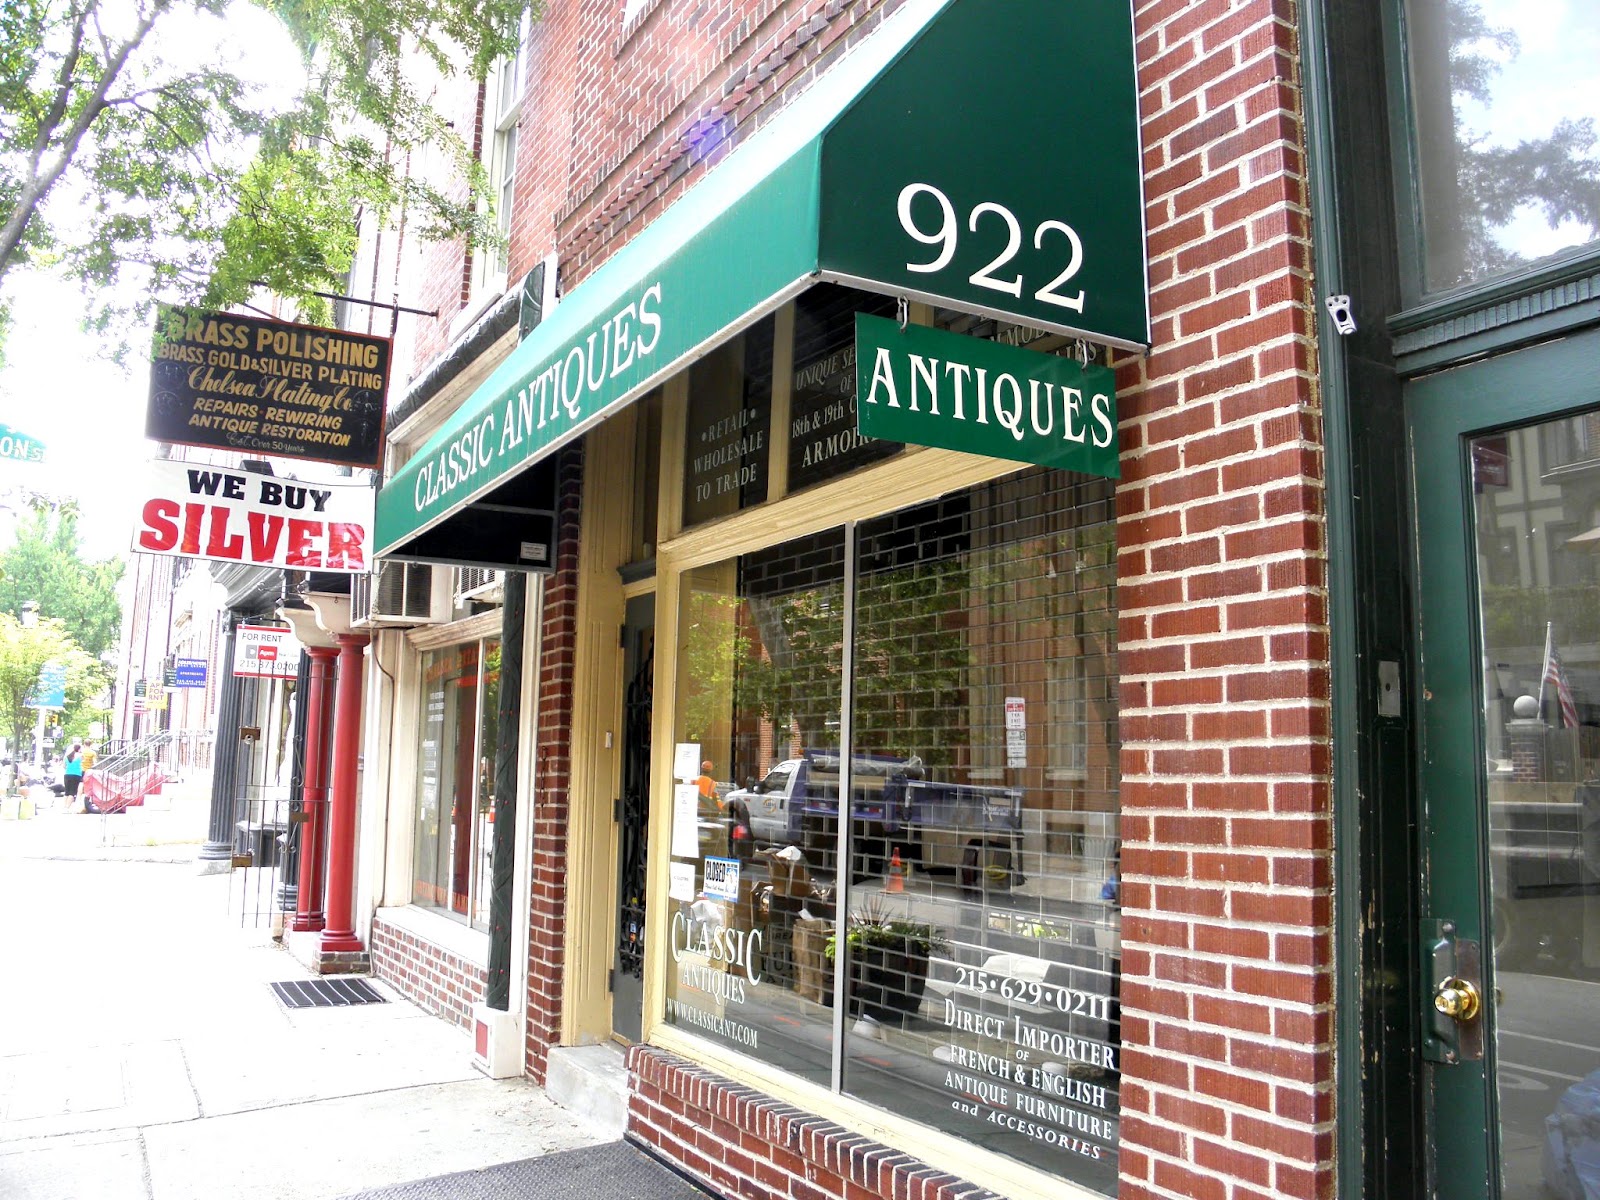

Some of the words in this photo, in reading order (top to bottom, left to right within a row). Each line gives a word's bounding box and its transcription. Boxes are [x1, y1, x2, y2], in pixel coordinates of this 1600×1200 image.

[897, 182, 1085, 314] 922
[256, 328, 379, 369] POLISHING
[187, 364, 257, 397] Chelsea
[255, 375, 334, 413] Plating
[318, 365, 382, 390] PLATING
[796, 355, 838, 391] UNIQUE
[840, 374, 853, 393] OF
[193, 398, 259, 418] REPAIRS
[265, 406, 343, 430] REWIRING
[414, 413, 495, 512] CLASSIC
[498, 282, 662, 456] ANTIQUES
[792, 415, 810, 438] 18th
[812, 411, 821, 430] &
[823, 400, 844, 425] 19th
[866, 347, 1114, 449] ANTIQUES
[189, 413, 259, 433] ANTIQUE
[261, 423, 351, 447] RESTORATION
[272, 441, 283, 450] 50
[694, 430, 763, 475] WHOLESALE
[187, 469, 247, 500] WE
[260, 481, 332, 512] BUY
[696, 482, 711, 502] TO
[716, 463, 757, 495] TRADE
[139, 498, 365, 570] SILVER
[242, 632, 258, 641] FOR
[261, 634, 283, 642] RENT
[671, 911, 762, 986] CLASSIC
[682, 961, 745, 1006] ANTIQUES
[667, 998, 758, 1049] WWW.CLASSICANT.COM
[944, 998, 1005, 1040] DIRECT
[1014, 1015, 1115, 1070] IMPORTER
[950, 1044, 1010, 1080] FRENCH
[1014, 1064, 1026, 1086] &
[1031, 1067, 1106, 1109] ENGLISH
[1015, 1050, 1030, 1061] OF
[945, 1071, 1008, 1105] ANTIQUE
[1016, 1092, 1112, 1141] FURNITURE
[952, 1100, 978, 1117] and
[987, 1110, 1101, 1160] ACCESSORIES
